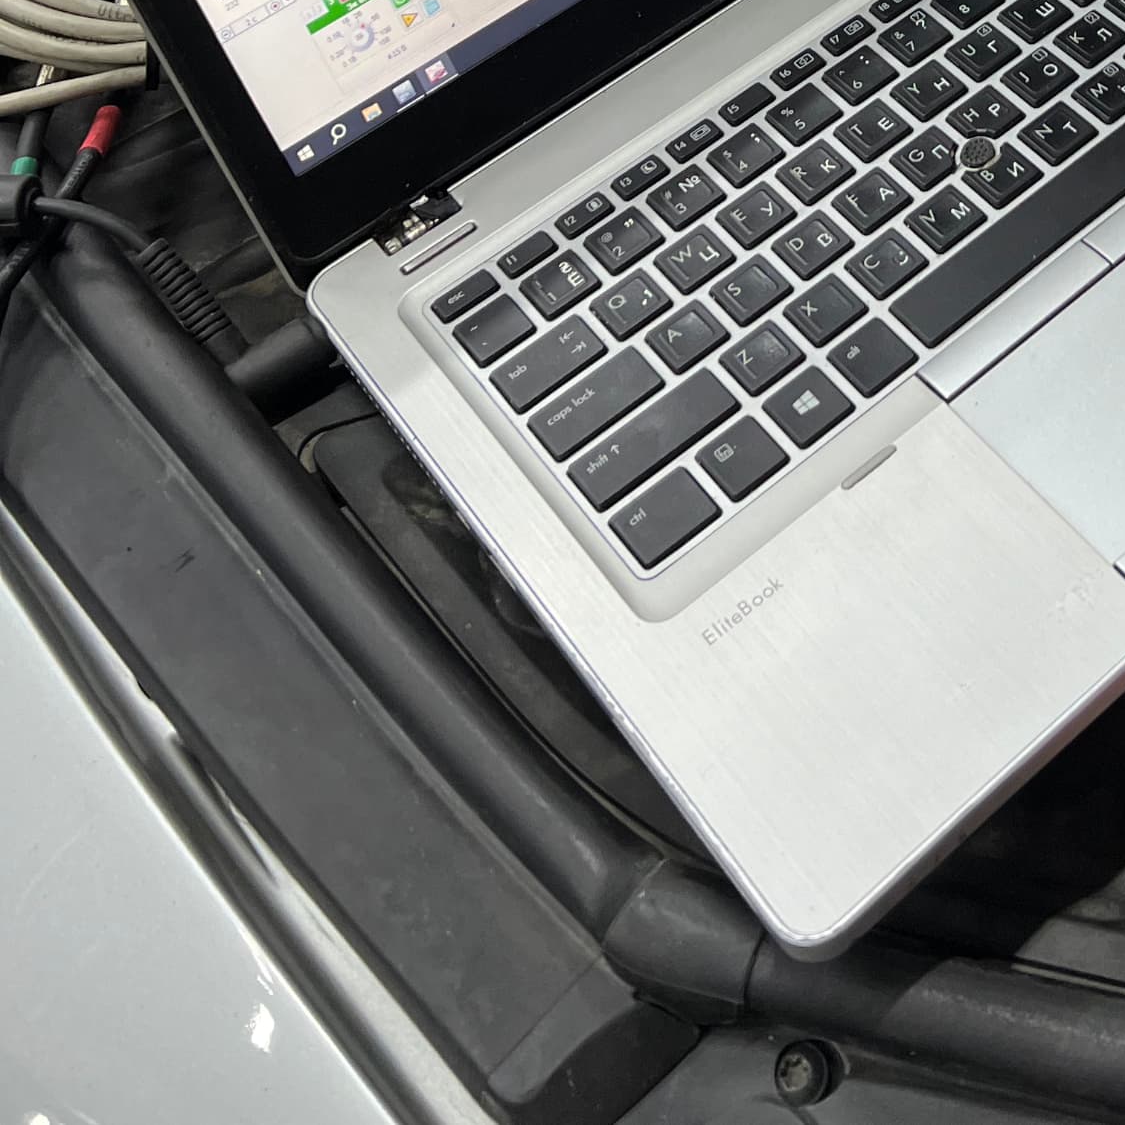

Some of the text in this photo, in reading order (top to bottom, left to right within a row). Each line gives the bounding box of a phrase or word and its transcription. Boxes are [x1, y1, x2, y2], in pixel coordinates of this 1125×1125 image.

[446, 289, 466, 306] esc
[844, 344, 861, 359] alt
[507, 362, 528, 380] tab
[545, 385, 596, 427] caps lock
[583, 451, 611, 475] shift
[626, 507, 647, 527] ctrl
[701, 577, 784, 646] EliteBook
